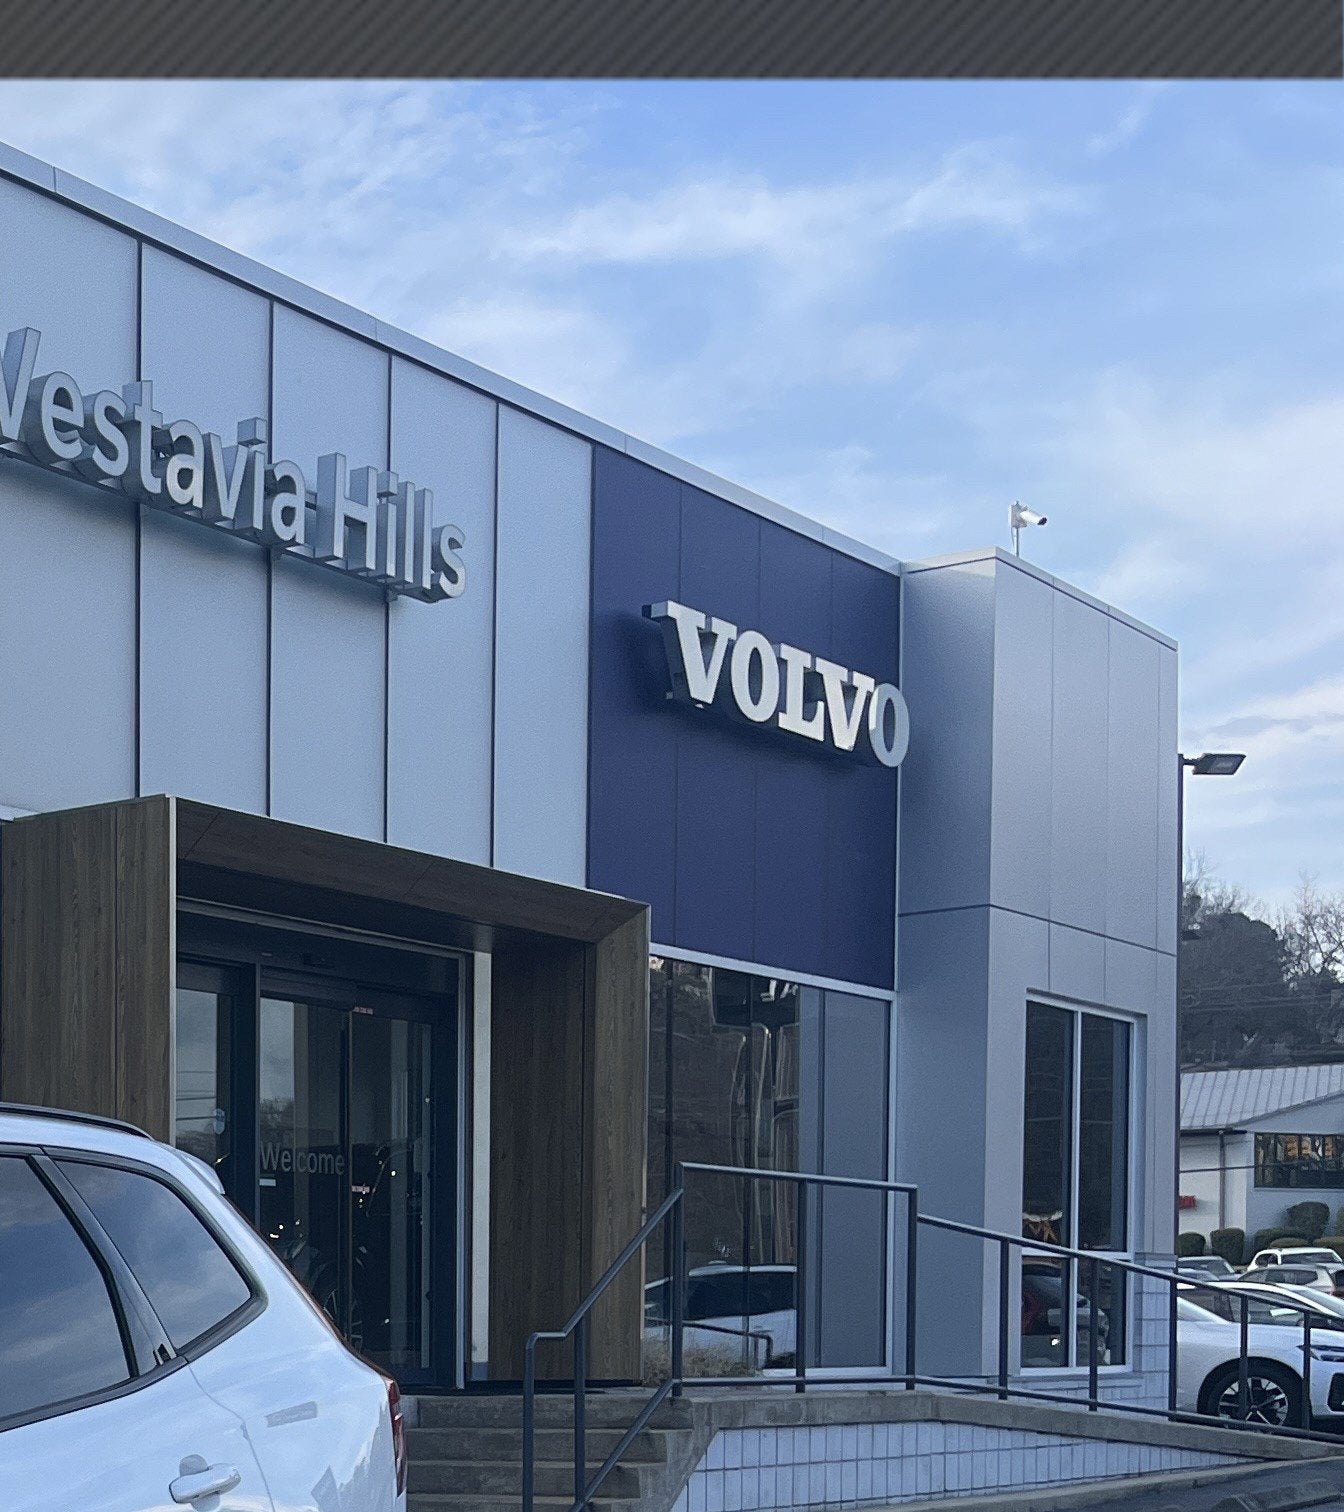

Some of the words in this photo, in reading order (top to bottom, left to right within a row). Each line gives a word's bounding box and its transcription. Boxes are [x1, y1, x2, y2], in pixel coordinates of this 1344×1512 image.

[318, 452, 466, 598] Hills
[657, 600, 909, 767] VOLVO
[262, 1142, 345, 1175] Welcome
